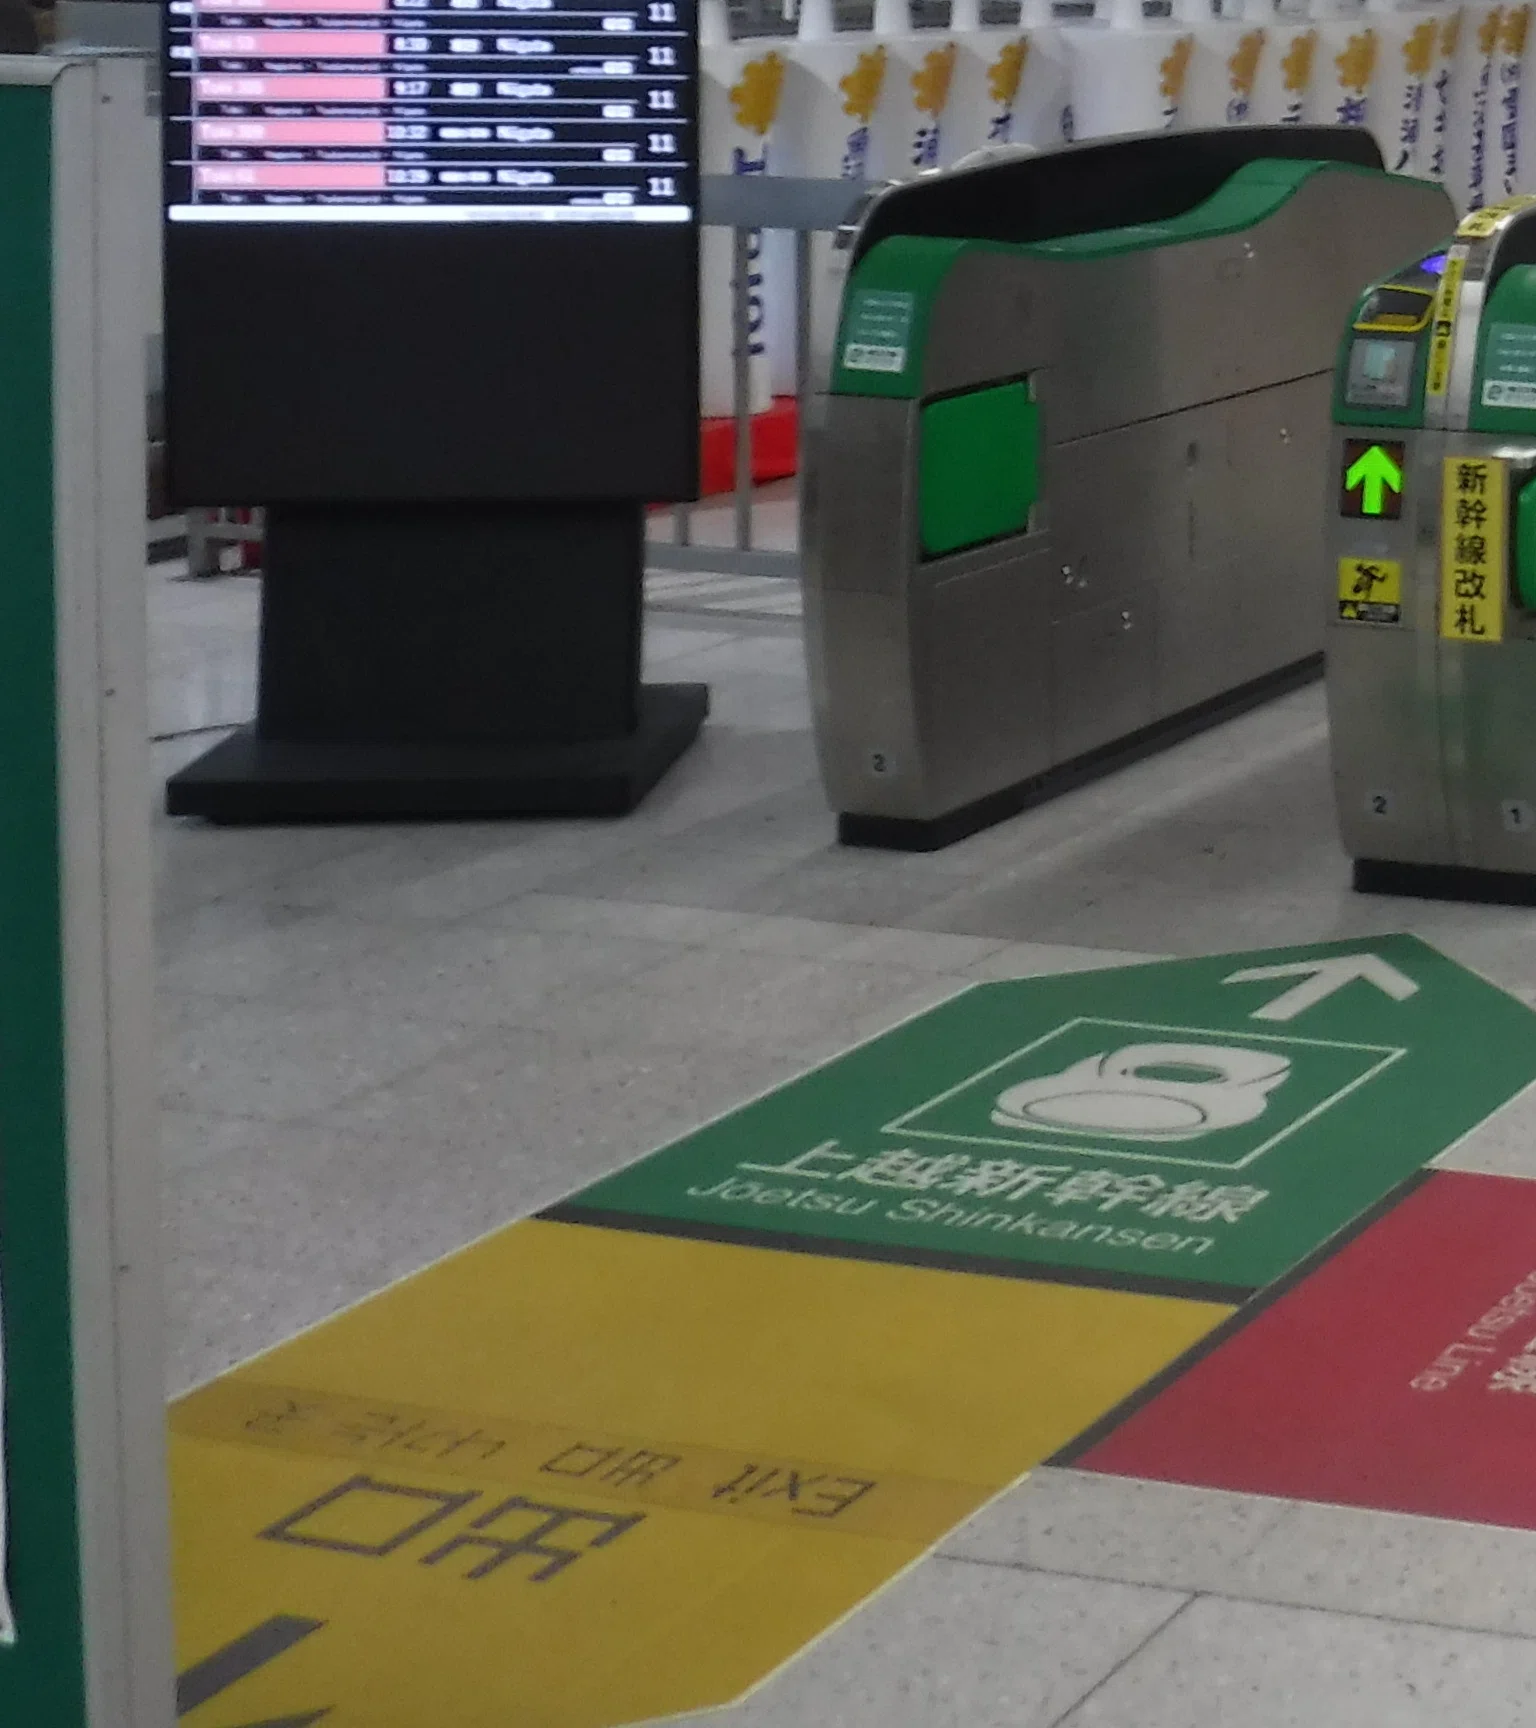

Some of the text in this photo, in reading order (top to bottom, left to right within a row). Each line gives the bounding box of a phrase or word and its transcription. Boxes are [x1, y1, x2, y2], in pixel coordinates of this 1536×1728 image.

[1455, 461, 1489, 638] 新幹線改札
[1373, 794, 1388, 815] 2
[737, 1138, 1270, 1225] 上越新幹線
[885, 1196, 1216, 1256] Shinkansen
[712, 1462, 877, 1519] Exit
[254, 1475, 648, 1583] 出口
